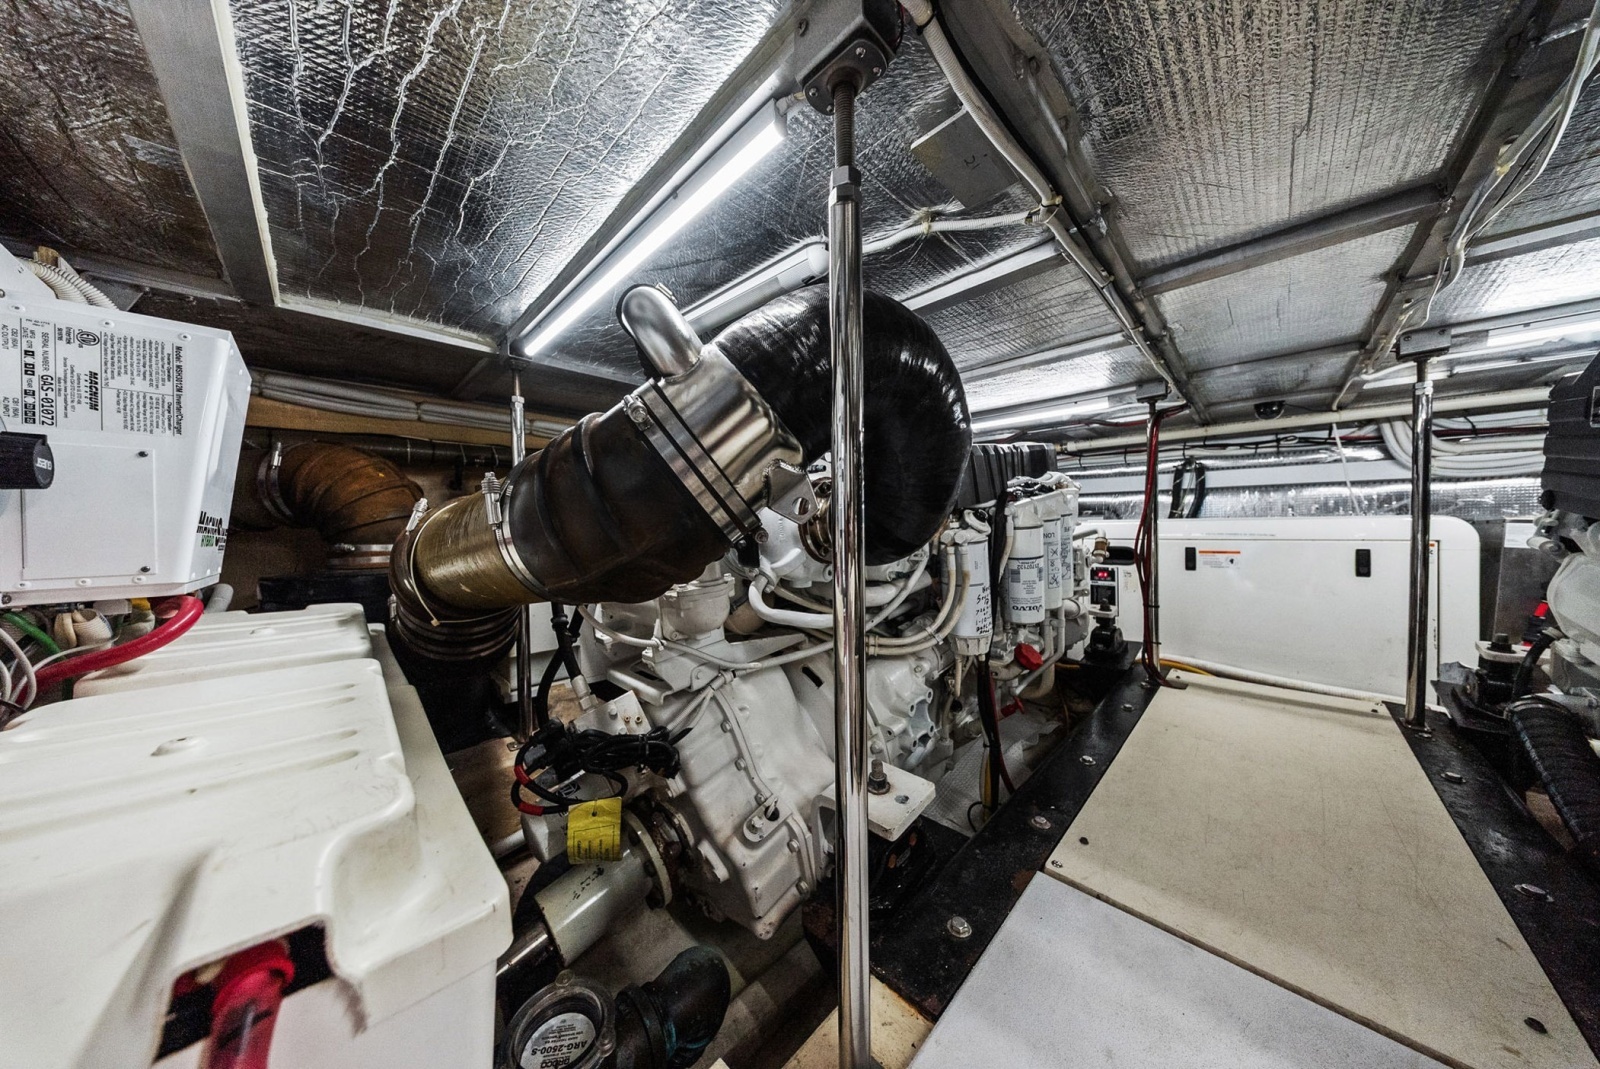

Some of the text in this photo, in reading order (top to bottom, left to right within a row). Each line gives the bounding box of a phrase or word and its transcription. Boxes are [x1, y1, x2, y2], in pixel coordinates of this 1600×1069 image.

[2, 324, 8, 332] AC
[42, 332, 50, 348] SERIAL
[89, 371, 99, 411] MAGNUM
[41, 374, 54, 426] GAS-01072
[1012, 604, 1043, 613] VOLVO
[531, 1040, 588, 1056] ARG-2500-S
